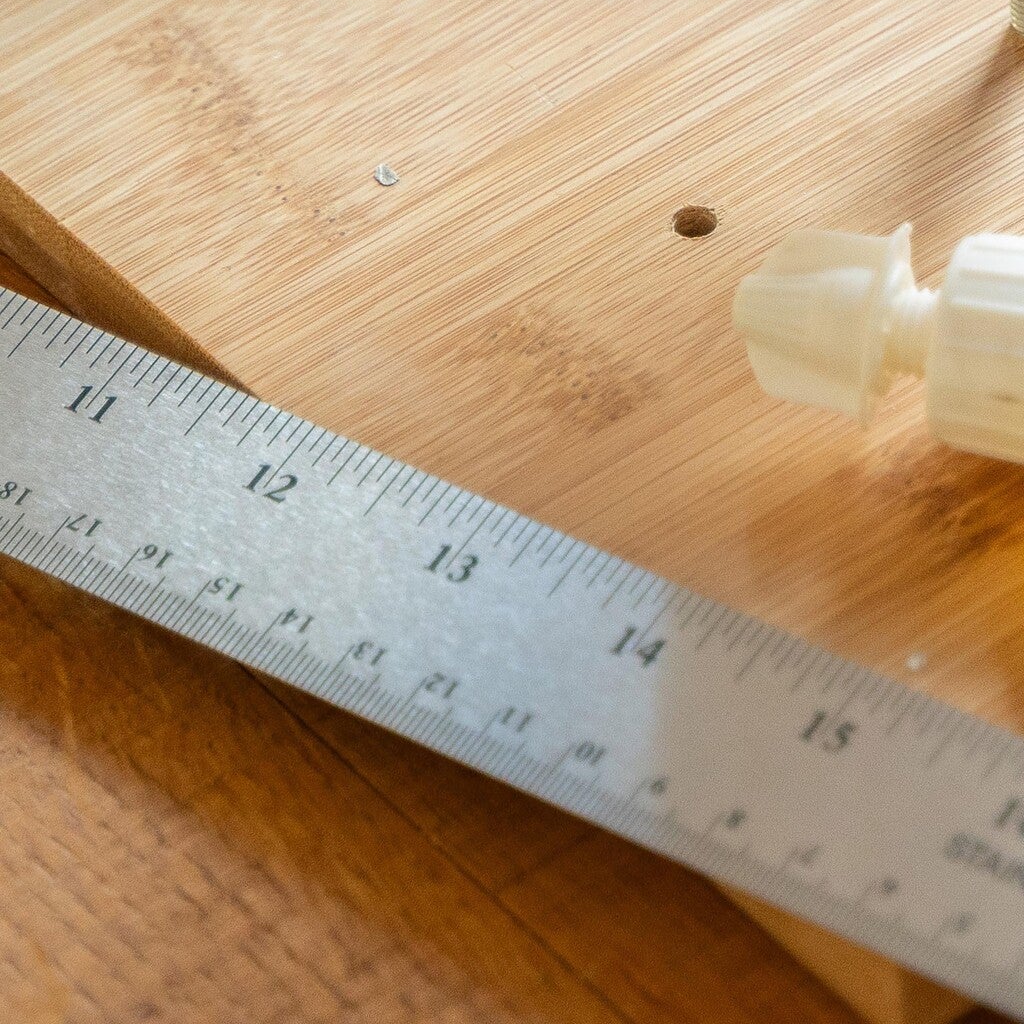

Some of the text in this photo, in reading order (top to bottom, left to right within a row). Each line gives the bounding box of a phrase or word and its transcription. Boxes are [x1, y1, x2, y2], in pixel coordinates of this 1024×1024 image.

[0, 481, 32, 506] 18
[65, 514, 102, 537] 17
[143, 543, 174, 569] 16
[208, 577, 245, 601] 15
[280, 607, 315, 635] 14
[352, 640, 388, 666] 13
[424, 674, 458, 700] 12
[499, 706, 536, 733] 11
[574, 740, 608, 767] 10
[64, 384, 118, 424] 11
[242, 463, 299, 504] 12
[424, 543, 480, 583] 13
[610, 626, 666, 669] 14
[800, 709, 857, 755] 15
